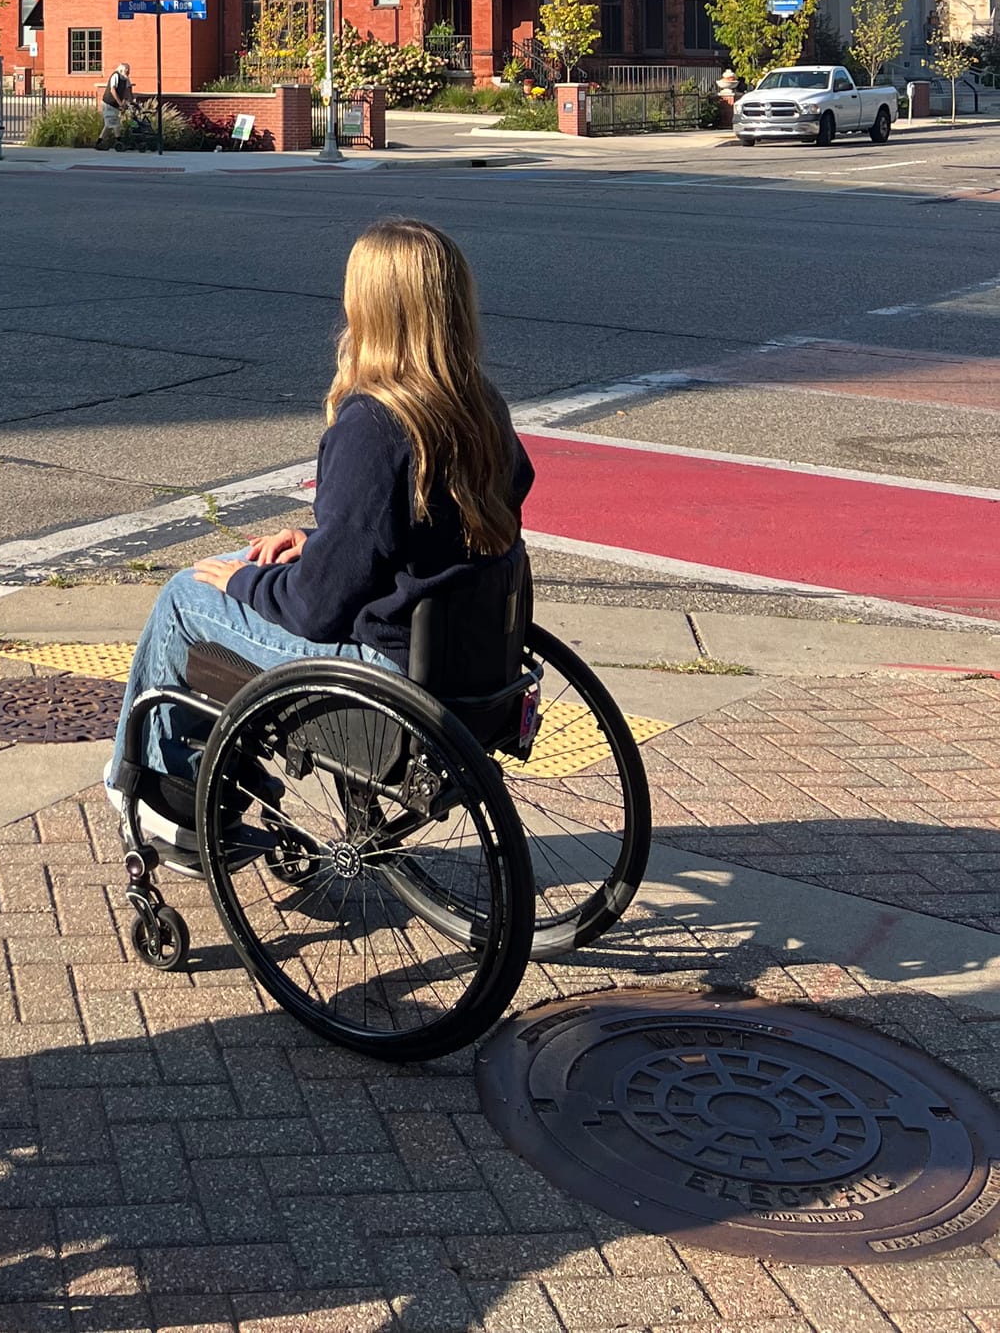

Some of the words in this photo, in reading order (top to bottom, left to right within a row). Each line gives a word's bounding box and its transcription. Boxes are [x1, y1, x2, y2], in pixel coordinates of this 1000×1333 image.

[128, 1, 147, 11] South
[173, 0, 193, 10] Rose
[686, 1171, 897, 1207] ELECTRIC
[755, 1210, 801, 1222] MADE
[807, 1213, 825, 1222] IN
[828, 1211, 860, 1222] USA
[881, 1233, 922, 1250] EAST
